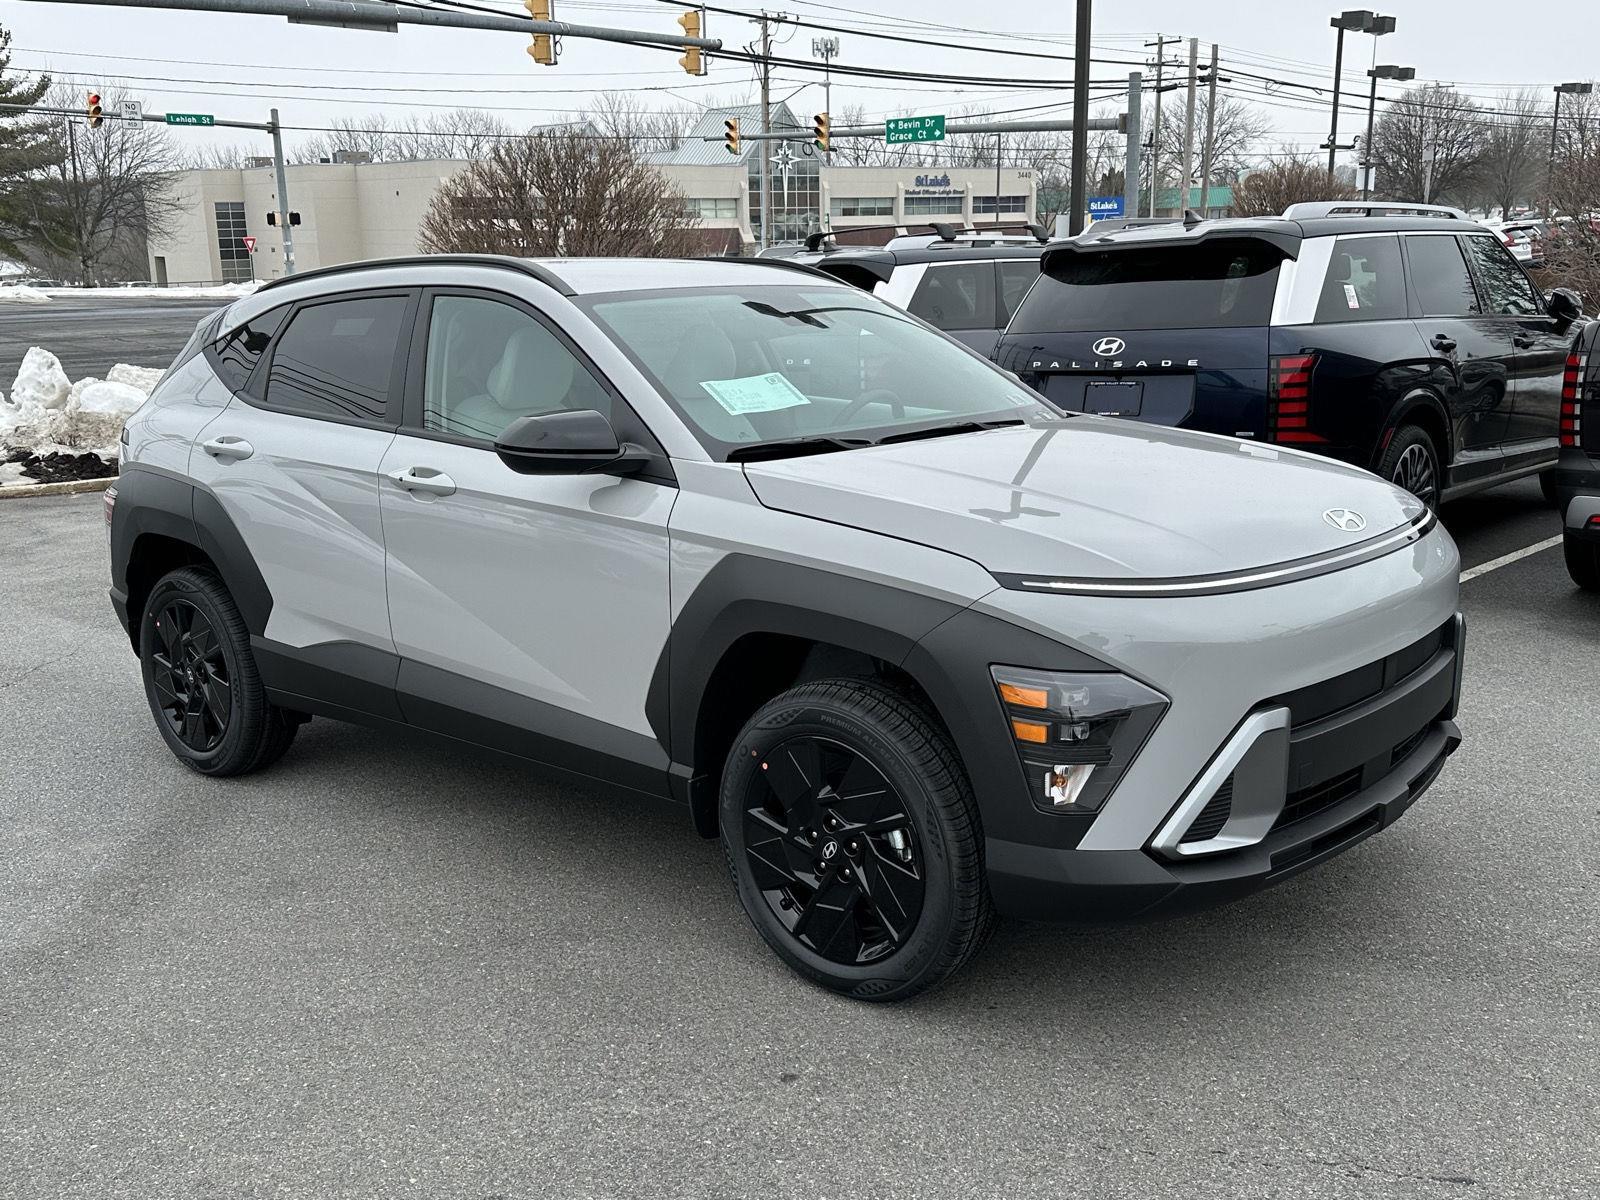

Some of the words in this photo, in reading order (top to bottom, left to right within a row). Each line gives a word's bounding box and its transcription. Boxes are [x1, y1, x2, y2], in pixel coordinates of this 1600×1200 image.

[170, 116, 197, 125] Lehigh
[898, 120, 920, 130] Bevin
[925, 118, 935, 128] Dr
[890, 132, 912, 141] Grace
[918, 130, 927, 139] Ct
[1017, 171, 1032, 179] 3440
[1032, 360, 1198, 368] PALISADE
